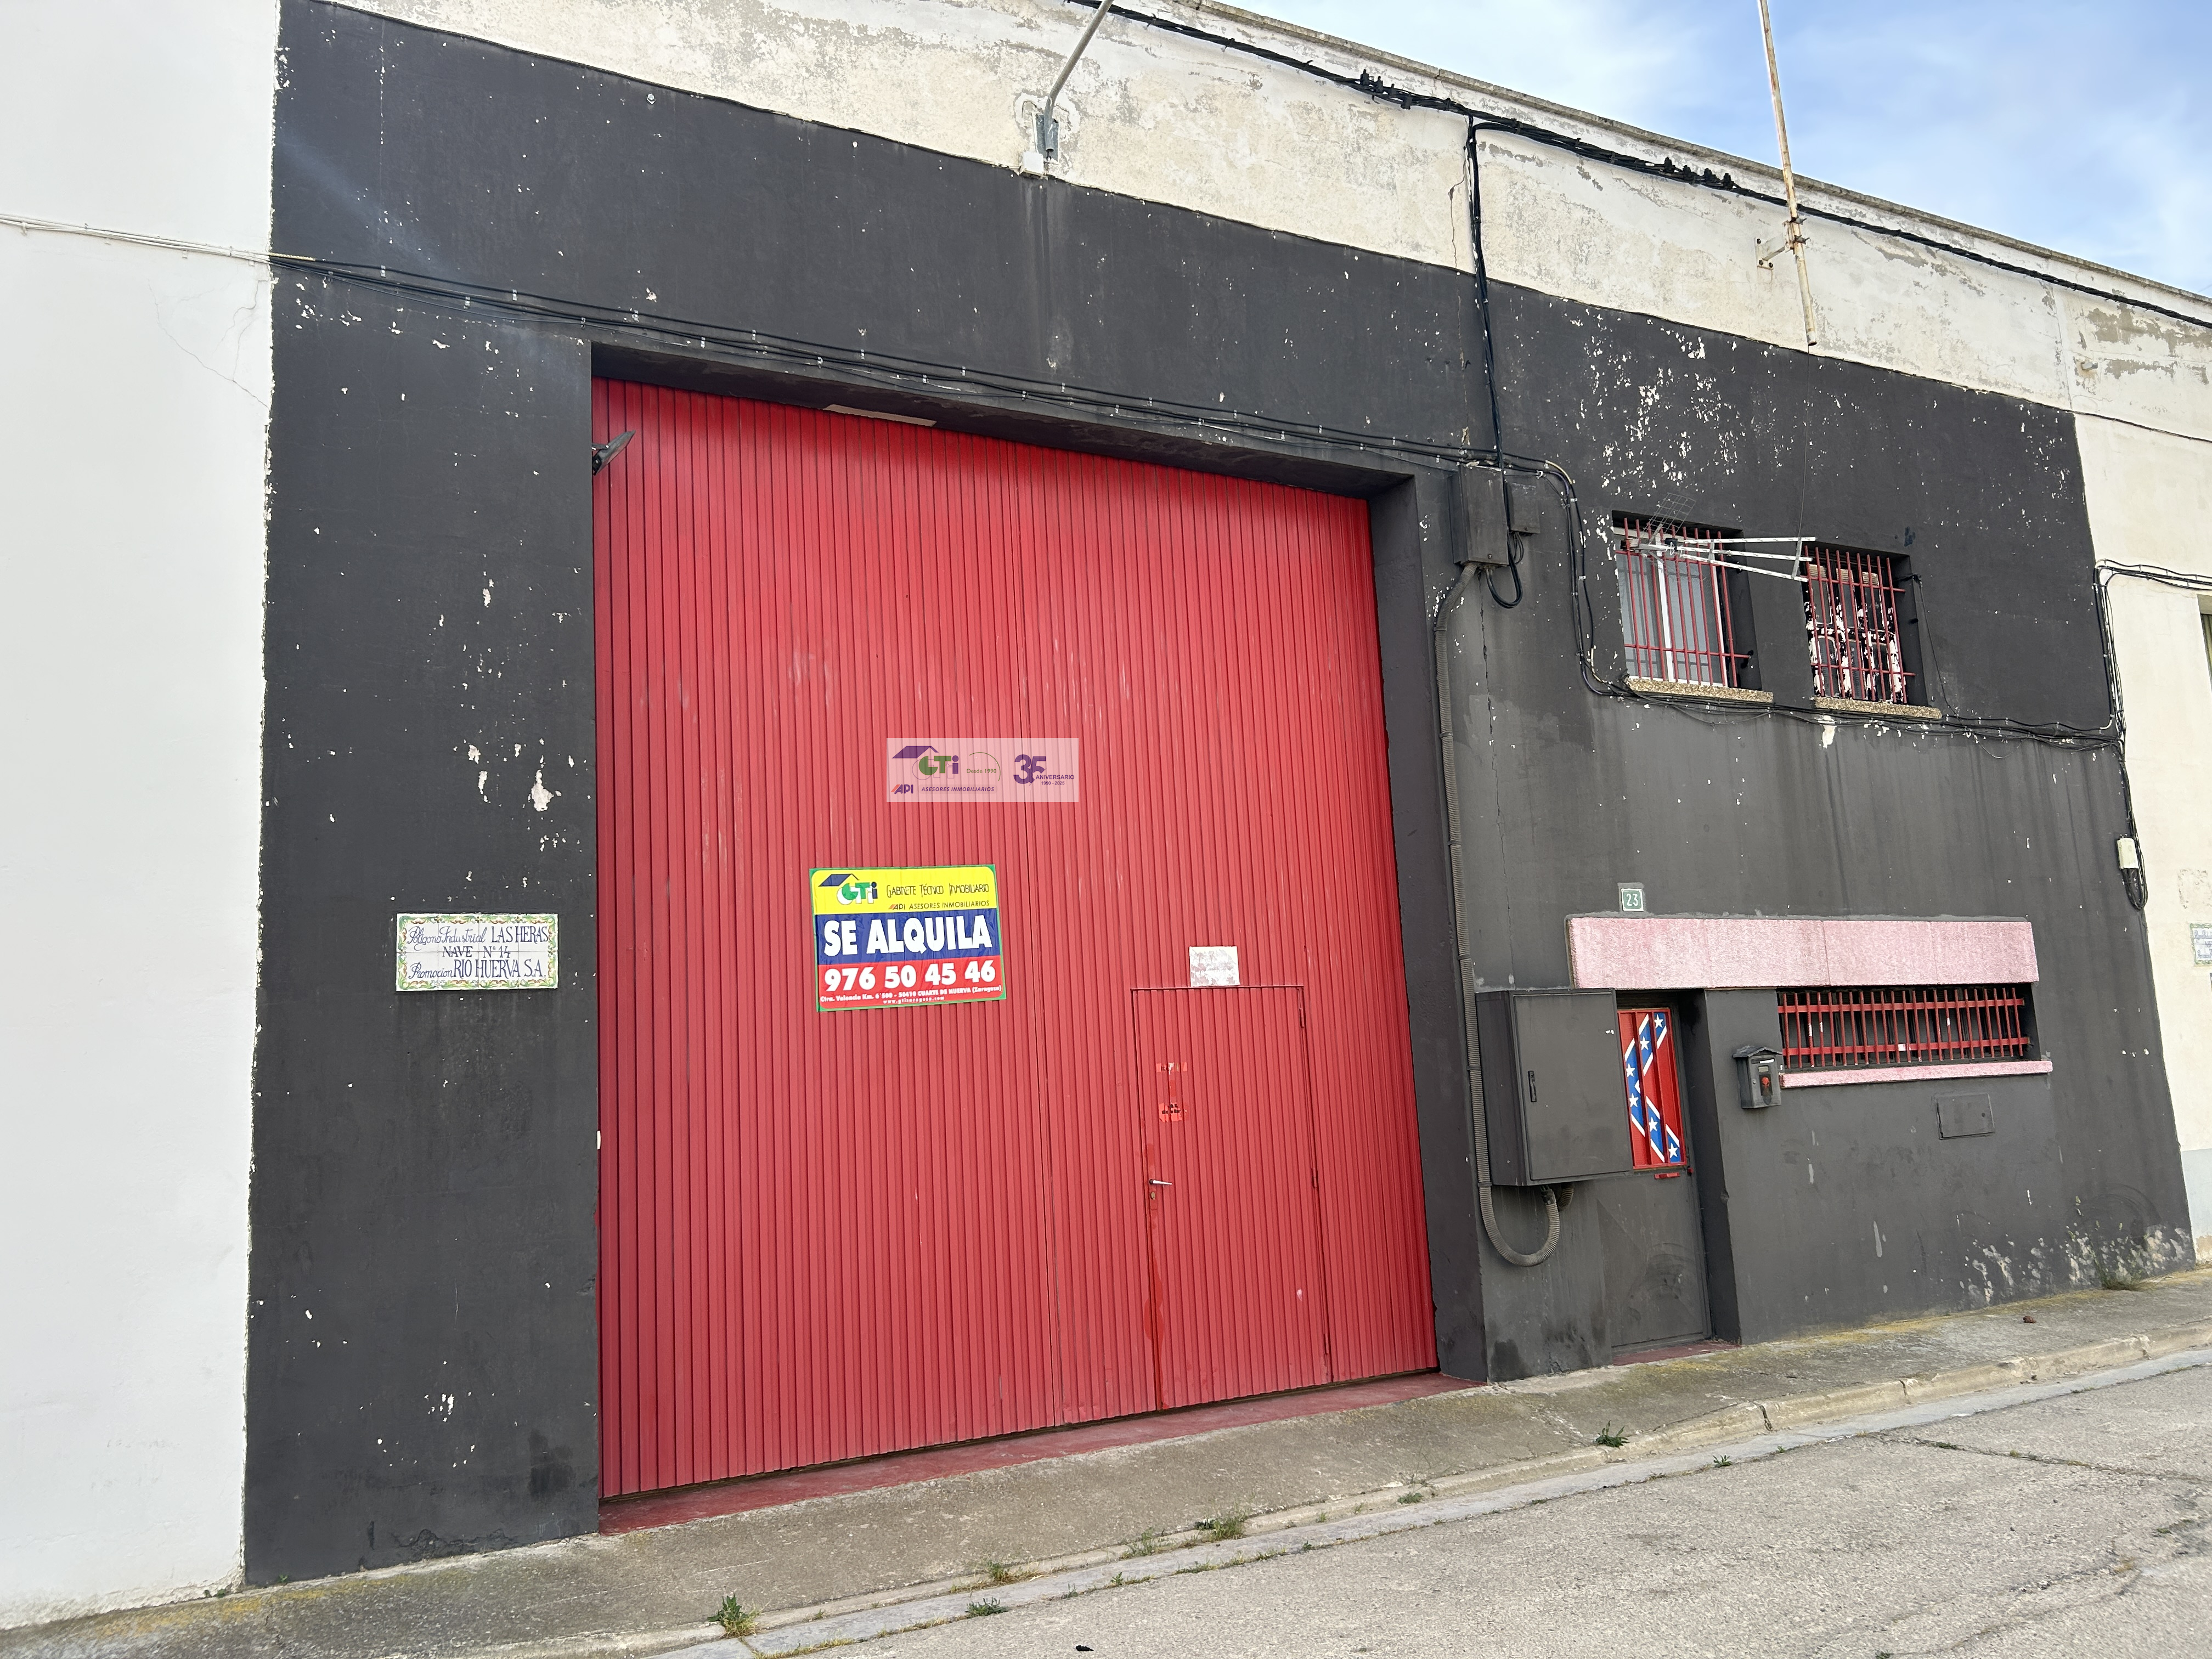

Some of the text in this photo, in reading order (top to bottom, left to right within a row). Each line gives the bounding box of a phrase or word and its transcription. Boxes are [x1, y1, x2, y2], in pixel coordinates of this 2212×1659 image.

[1626, 893, 1638, 906] 23
[439, 926, 486, 943] Industrial
[491, 926, 514, 943] LAS
[515, 926, 549, 944] HERAS
[824, 915, 992, 956] SE ALQUILA
[442, 946, 473, 958] NAVE
[499, 945, 511, 958] 14
[453, 959, 472, 979] RIO
[475, 959, 521, 979] HUERVA
[825, 960, 996, 992] 976 50 45 46
